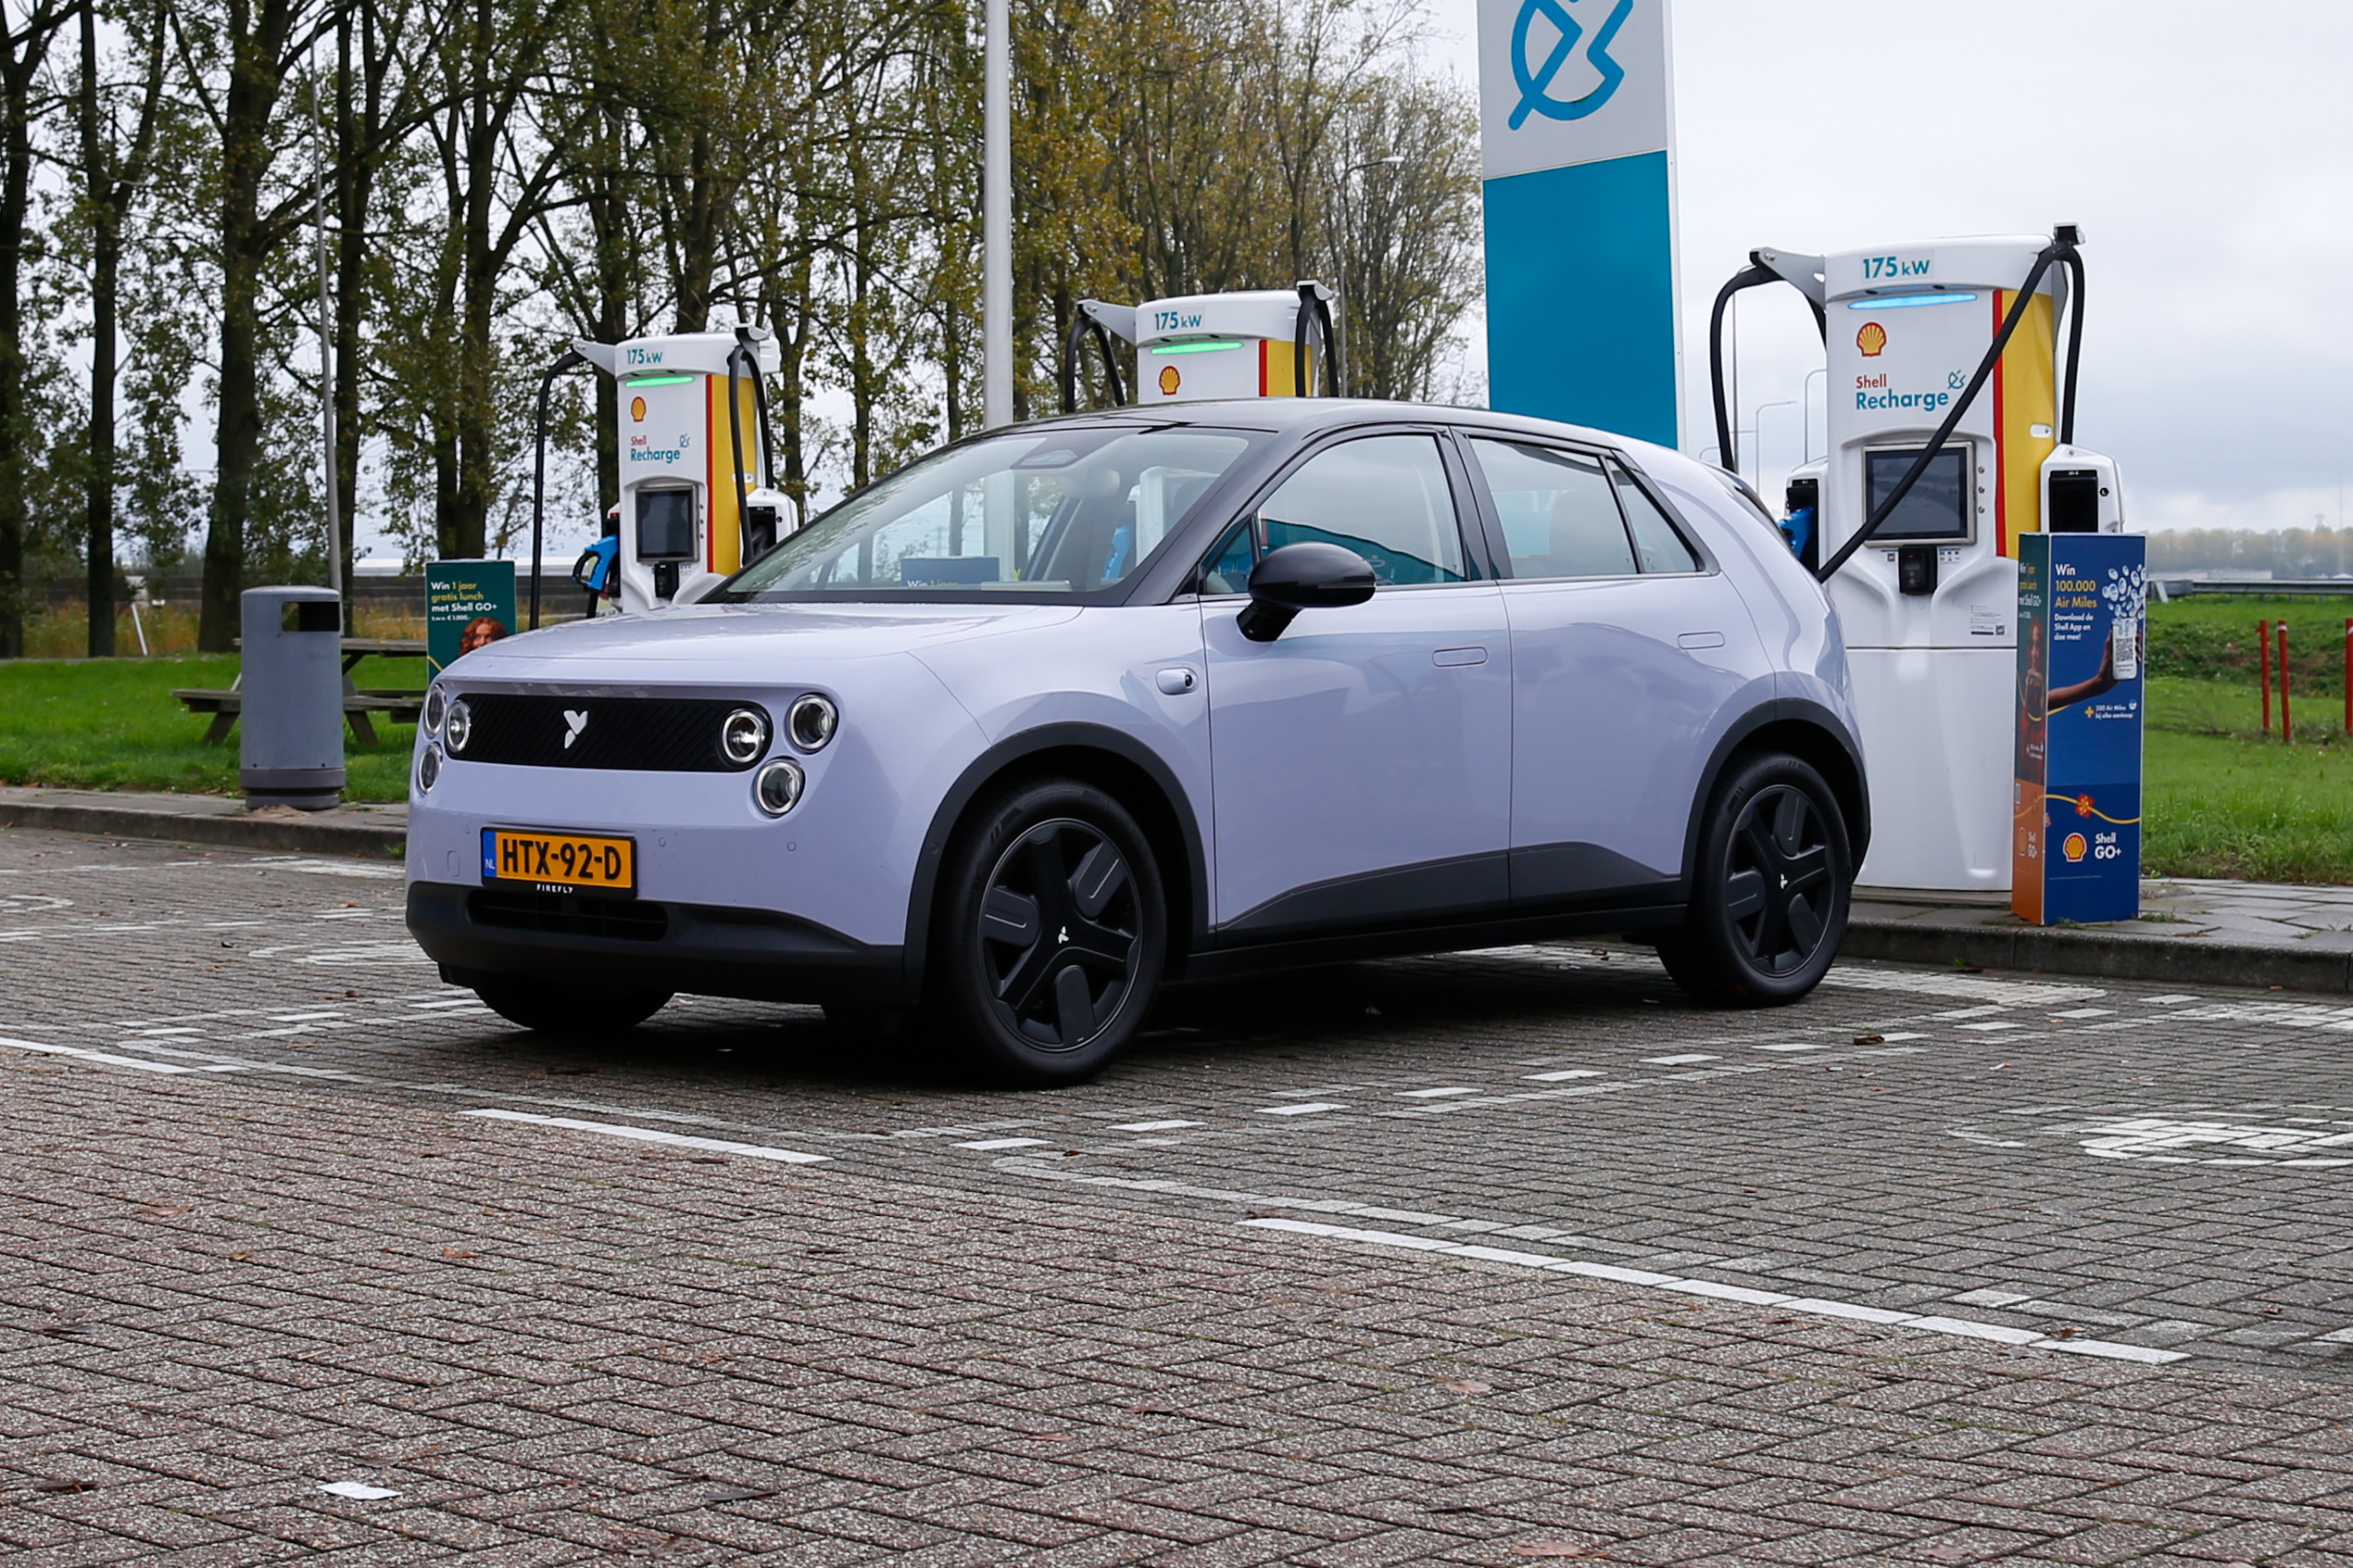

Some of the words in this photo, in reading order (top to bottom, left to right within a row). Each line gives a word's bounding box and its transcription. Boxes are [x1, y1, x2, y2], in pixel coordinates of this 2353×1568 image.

[1863, 256, 1898, 278] 175
[1902, 260, 1930, 276] kW
[1154, 312, 1179, 331] 175
[1181, 314, 1202, 328] kW
[627, 348, 645, 365] 175
[646, 352, 663, 364] kW
[1856, 373, 1887, 389] Shell
[1856, 389, 1949, 412] Recharge
[631, 435, 647, 446] Shell
[631, 446, 681, 464] Recharge
[2055, 563, 2076, 576] Win
[430, 581, 450, 591] Win
[451, 581, 456, 590] 1
[458, 581, 477, 592] jaar
[2055, 580, 2097, 592] 100.000
[431, 593, 458, 604] gratis
[460, 591, 484, 600] lunch
[2054, 597, 2070, 608] Air
[2071, 596, 2097, 608] Miles
[431, 604, 449, 612] met
[451, 602, 473, 612] Shell
[475, 602, 497, 611] GO+
[2054, 613, 2085, 621] Download
[2086, 613, 2094, 621] de
[2054, 622, 2069, 631] Shell
[2070, 623, 2082, 631] App
[2095, 832, 2117, 844] Shell
[2095, 845, 2121, 859] GO+
[485, 858, 496, 869] NL
[502, 838, 621, 881] HTX-92-D
[536, 883, 574, 894] FIREFLY
